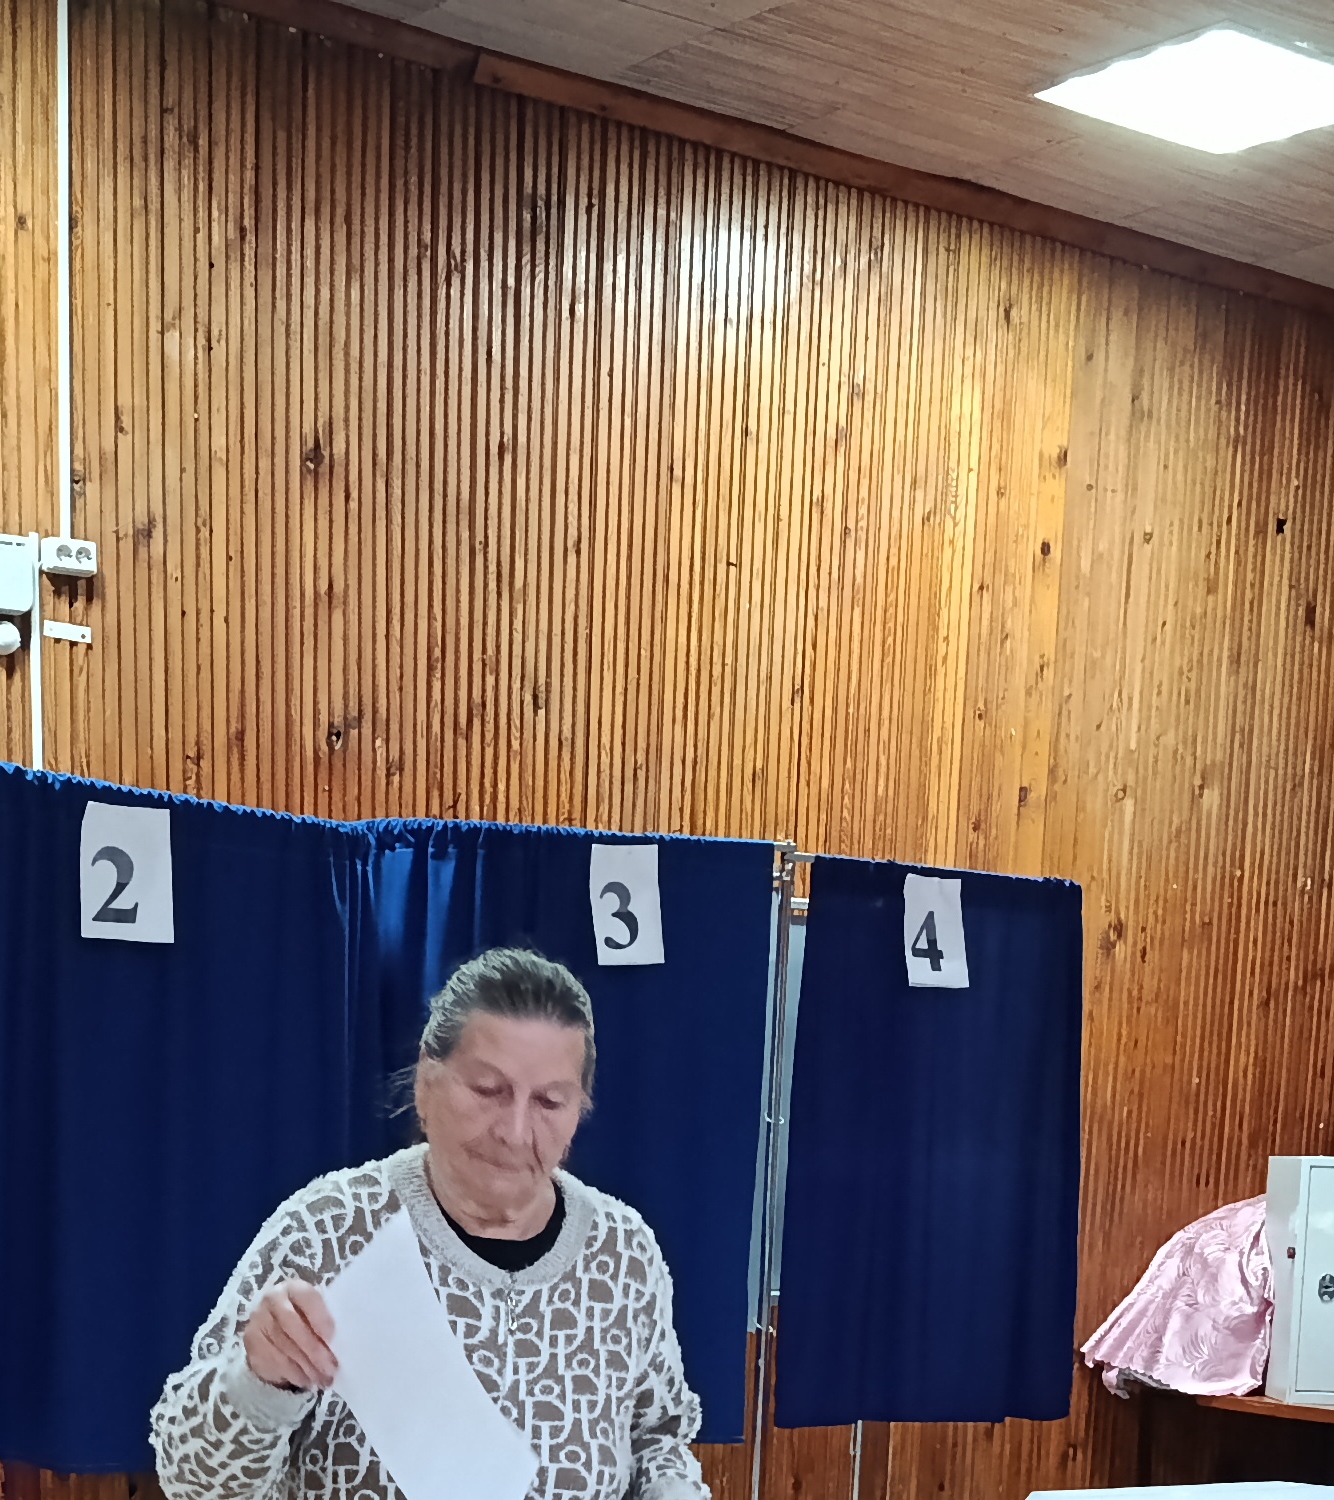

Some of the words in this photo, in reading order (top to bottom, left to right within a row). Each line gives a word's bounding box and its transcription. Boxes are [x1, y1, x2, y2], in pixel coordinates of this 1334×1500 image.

[90, 845, 139, 924] 2
[599, 881, 640, 950] 3
[910, 910, 945, 972] 4
